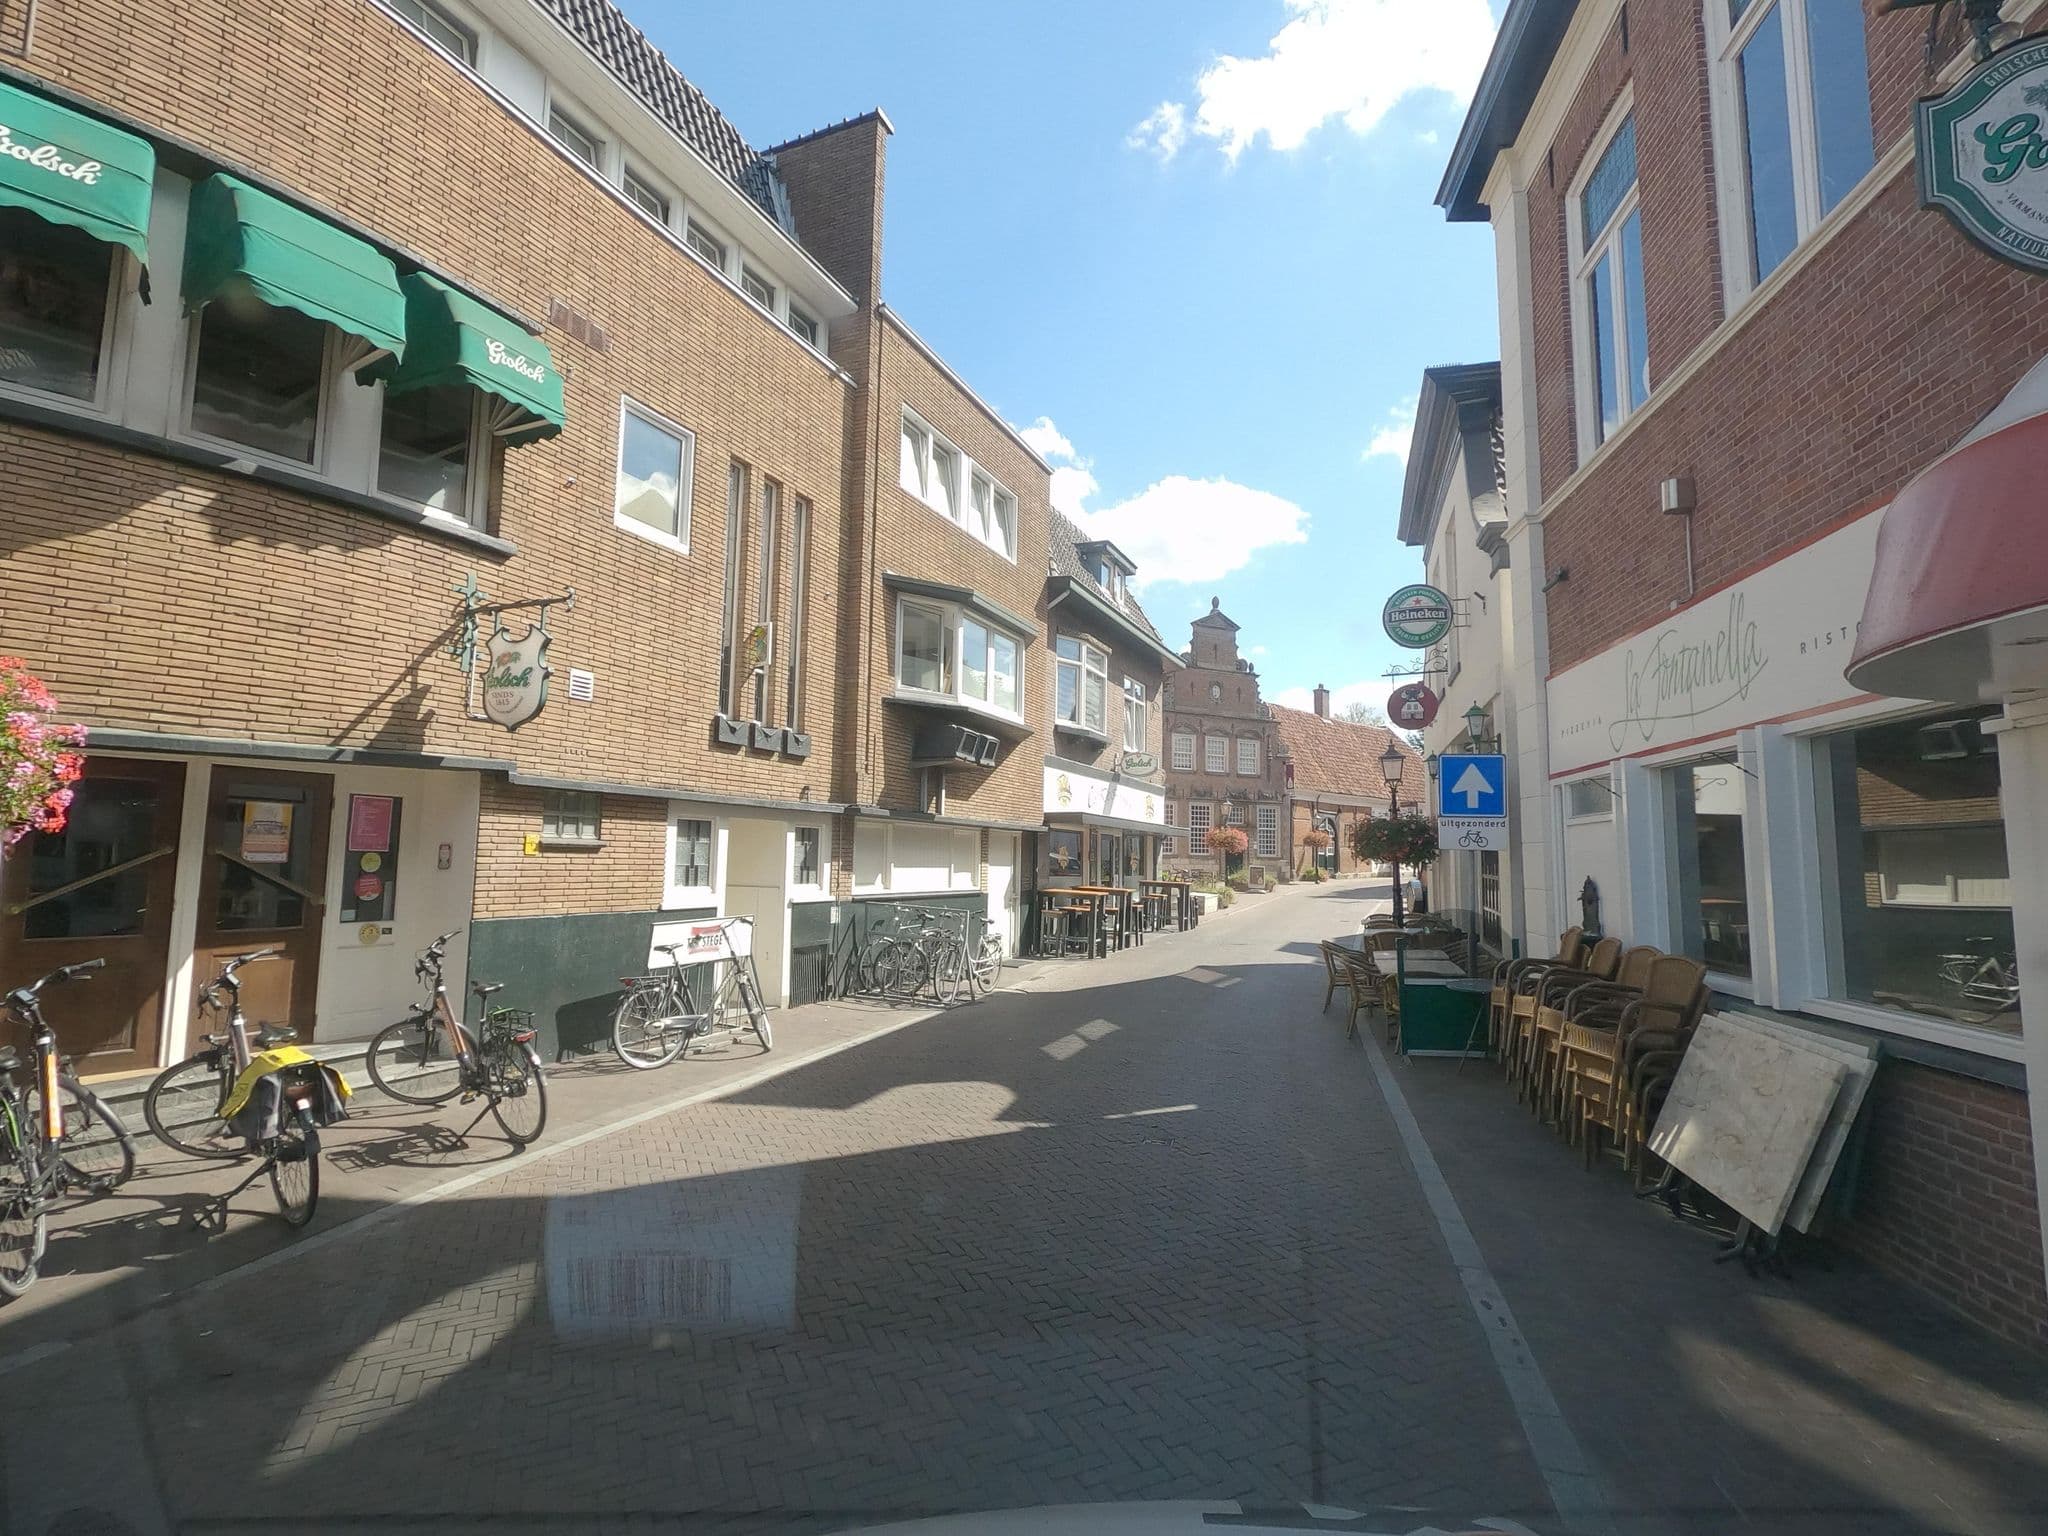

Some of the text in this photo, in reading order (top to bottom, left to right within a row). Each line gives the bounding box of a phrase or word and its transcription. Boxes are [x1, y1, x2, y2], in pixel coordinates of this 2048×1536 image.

[0, 124, 102, 185] rolsch
[485, 338, 544, 383] Grolsch
[1391, 609, 1445, 622] Heineken
[1638, 592, 1768, 742] Fontanella
[1441, 820, 1506, 829] uitgezonderd
